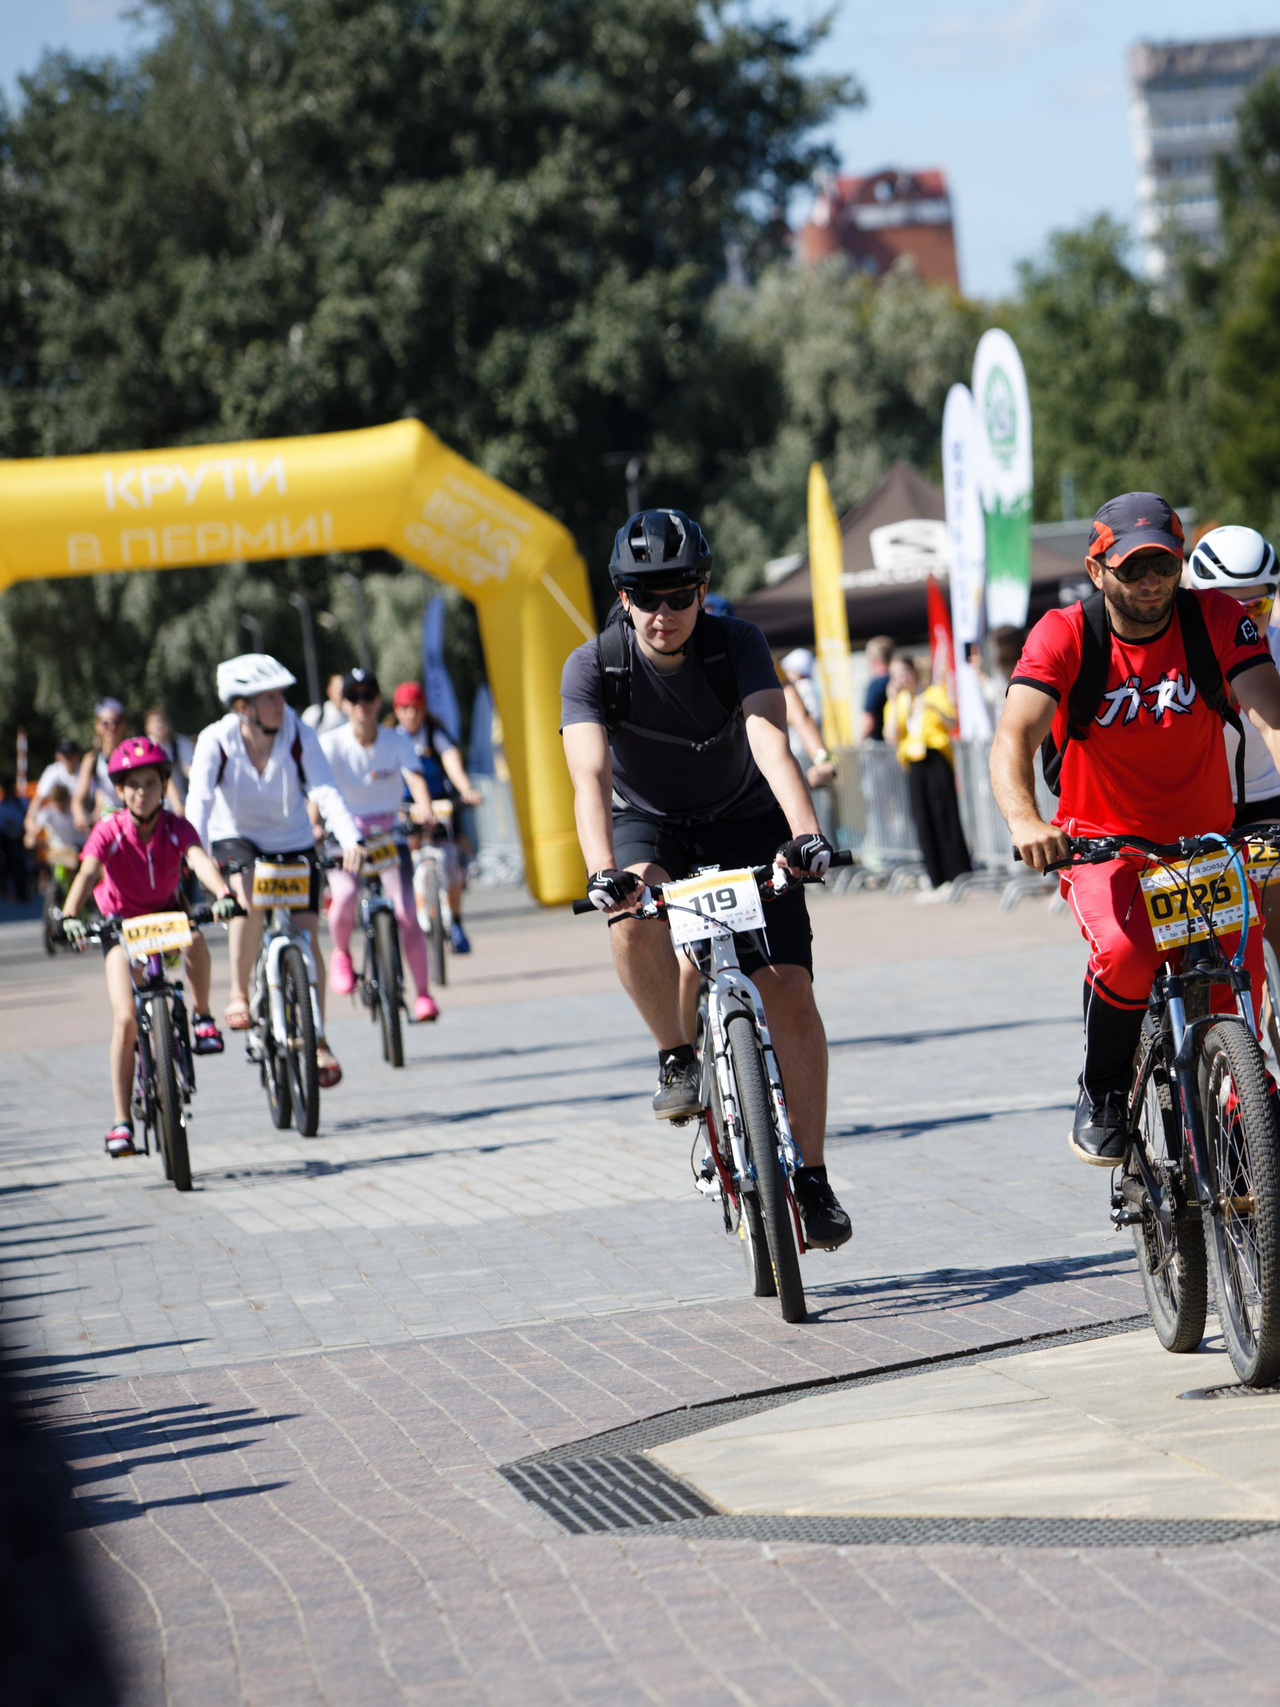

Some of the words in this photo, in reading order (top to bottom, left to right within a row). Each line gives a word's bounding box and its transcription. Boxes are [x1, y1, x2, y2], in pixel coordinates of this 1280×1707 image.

[104, 454, 287, 512] КРУТИ
[67, 532, 102, 571] В
[120, 510, 333, 566] ПЕРМИ!
[688, 887, 738, 916] 119
[1151, 877, 1232, 920] 0726
